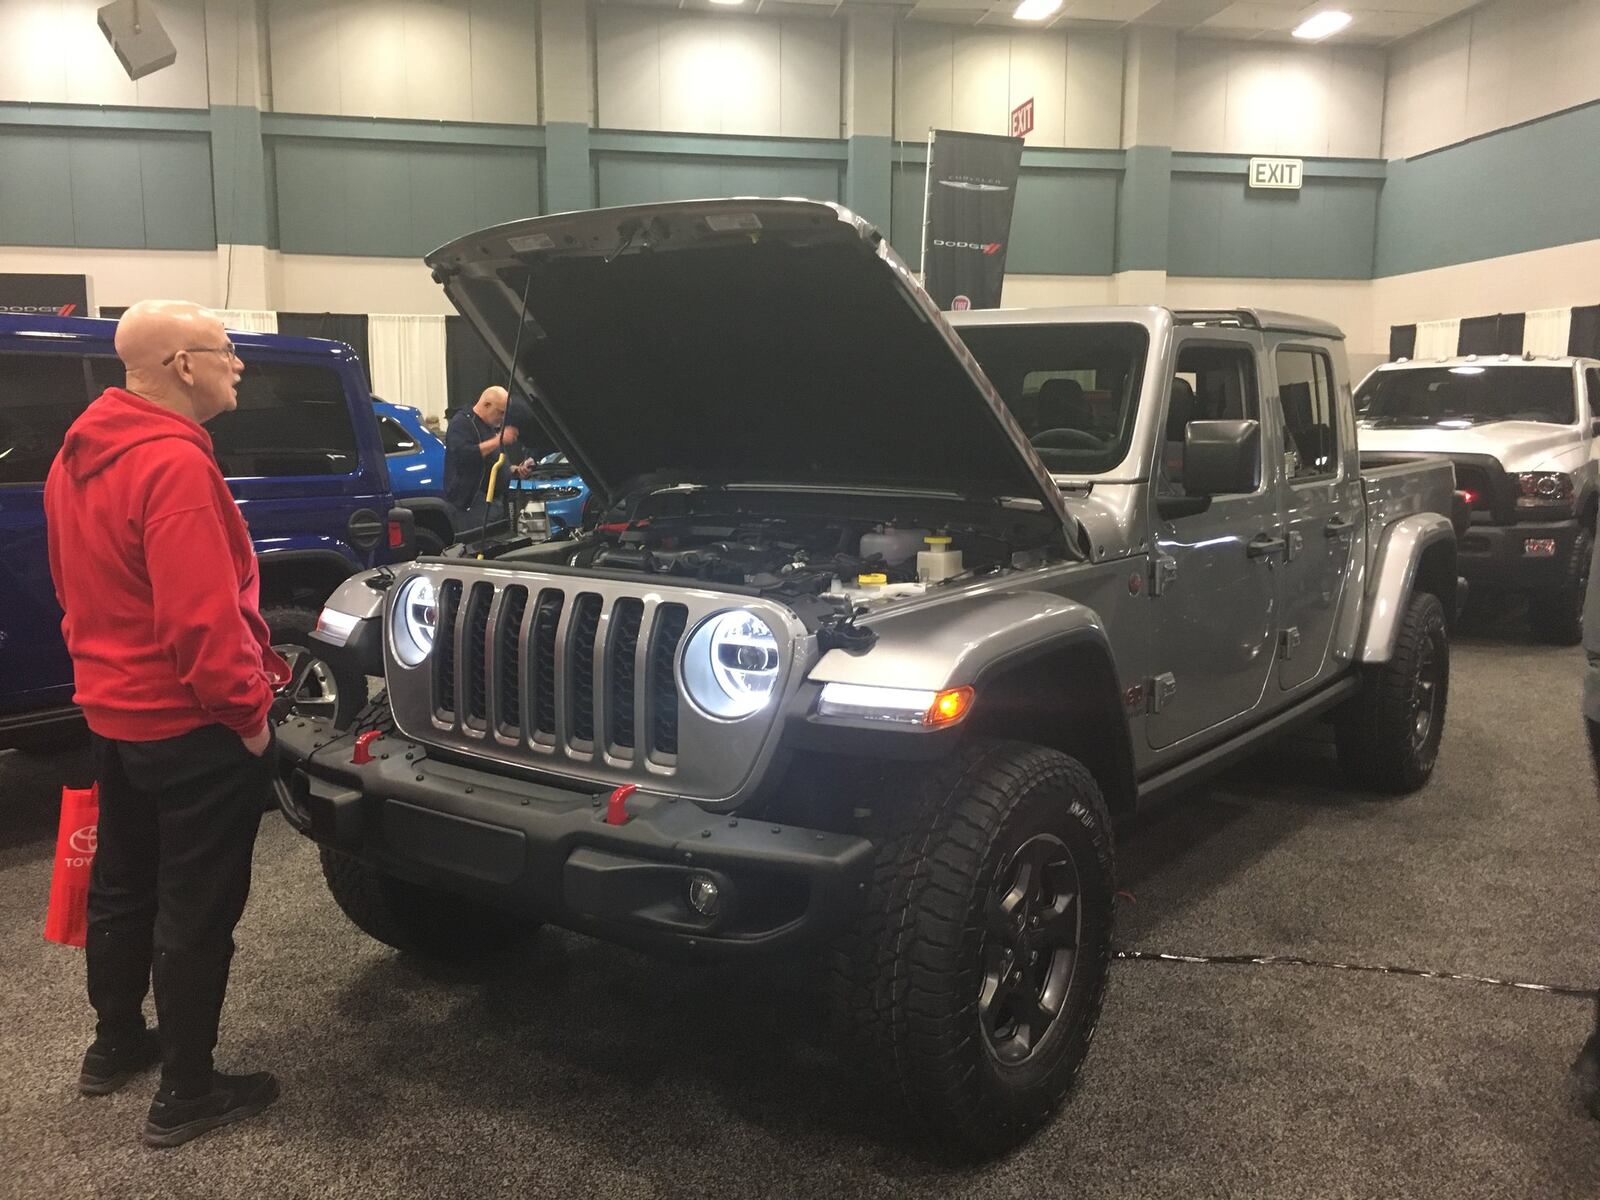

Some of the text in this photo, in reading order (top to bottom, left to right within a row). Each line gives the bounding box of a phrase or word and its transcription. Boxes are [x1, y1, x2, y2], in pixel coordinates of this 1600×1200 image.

[1012, 102, 1032, 137] EXIT
[1255, 163, 1297, 184] EXIT
[933, 239, 988, 251] DODGE
